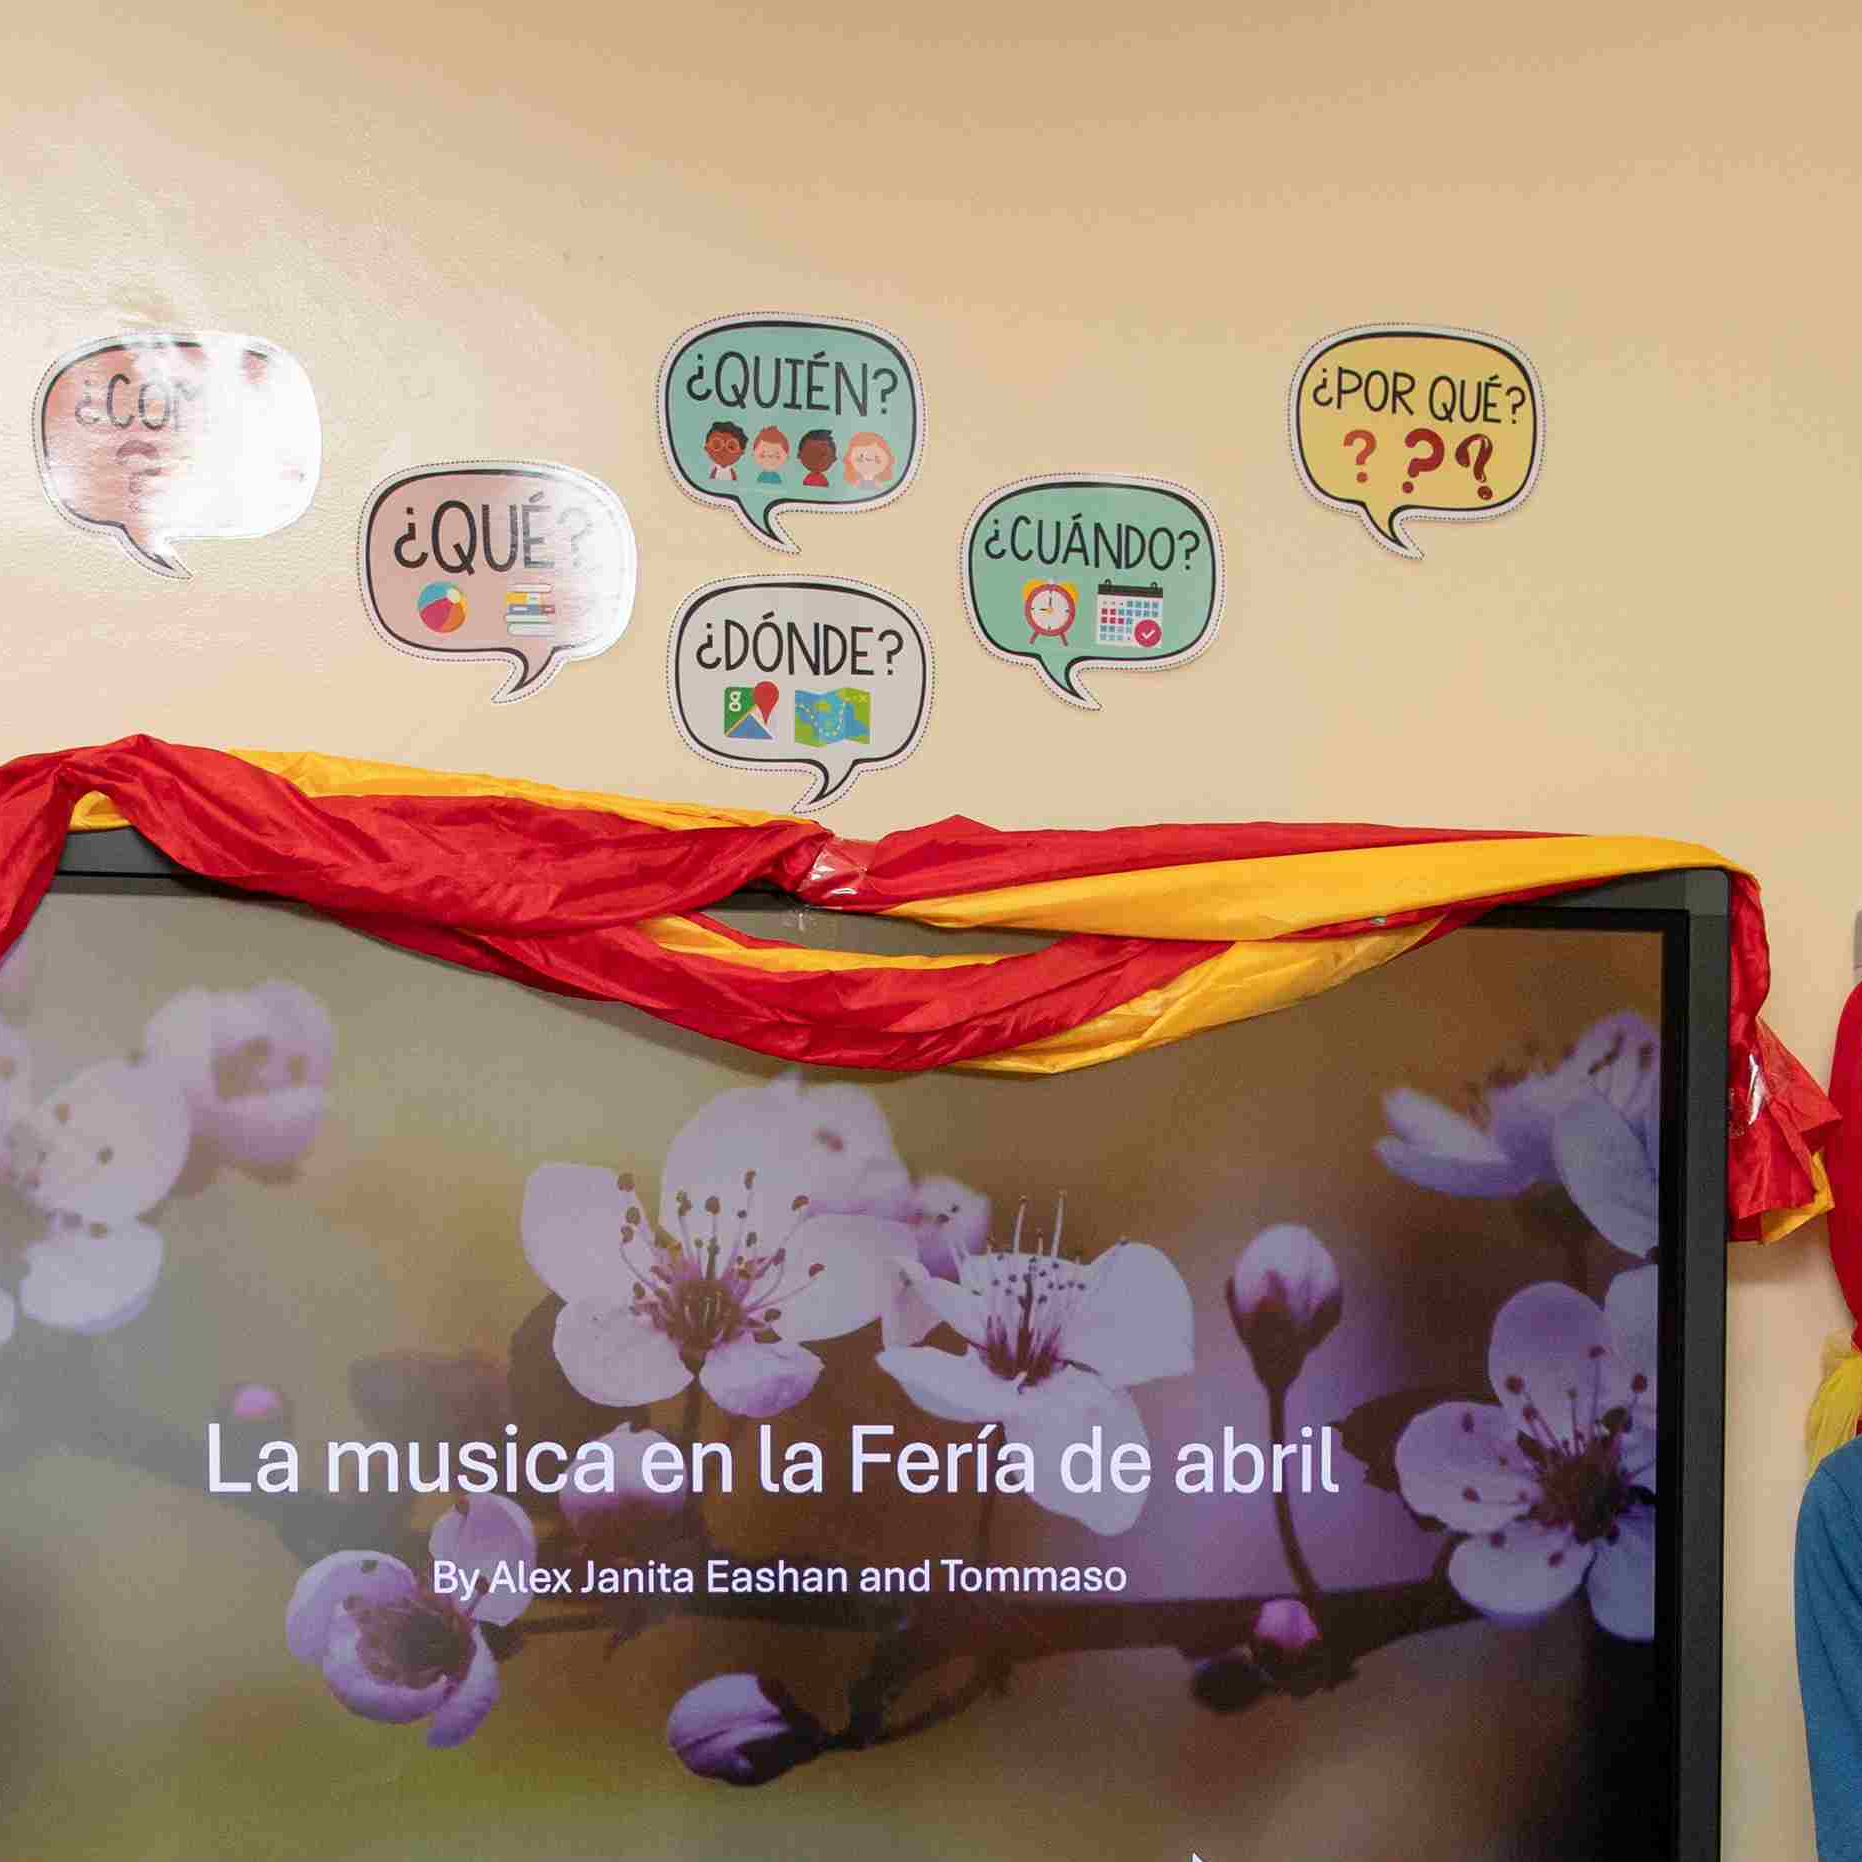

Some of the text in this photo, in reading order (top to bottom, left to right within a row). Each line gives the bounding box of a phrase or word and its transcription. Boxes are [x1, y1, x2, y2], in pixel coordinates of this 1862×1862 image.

[685, 349, 900, 418] ¿QUIÉN?
[1312, 364, 1527, 425] ¿POR QUÉ?
[392, 490, 594, 576] ¿QUÉ?
[983, 513, 1202, 574] ¿CUÁNDO?
[695, 611, 905, 679] ¿DÓNDE?
[206, 1423, 1338, 1494] La musica en la Fería de abril
[433, 1560, 1128, 1600] By Alex Janita Eashan and Tommaso
